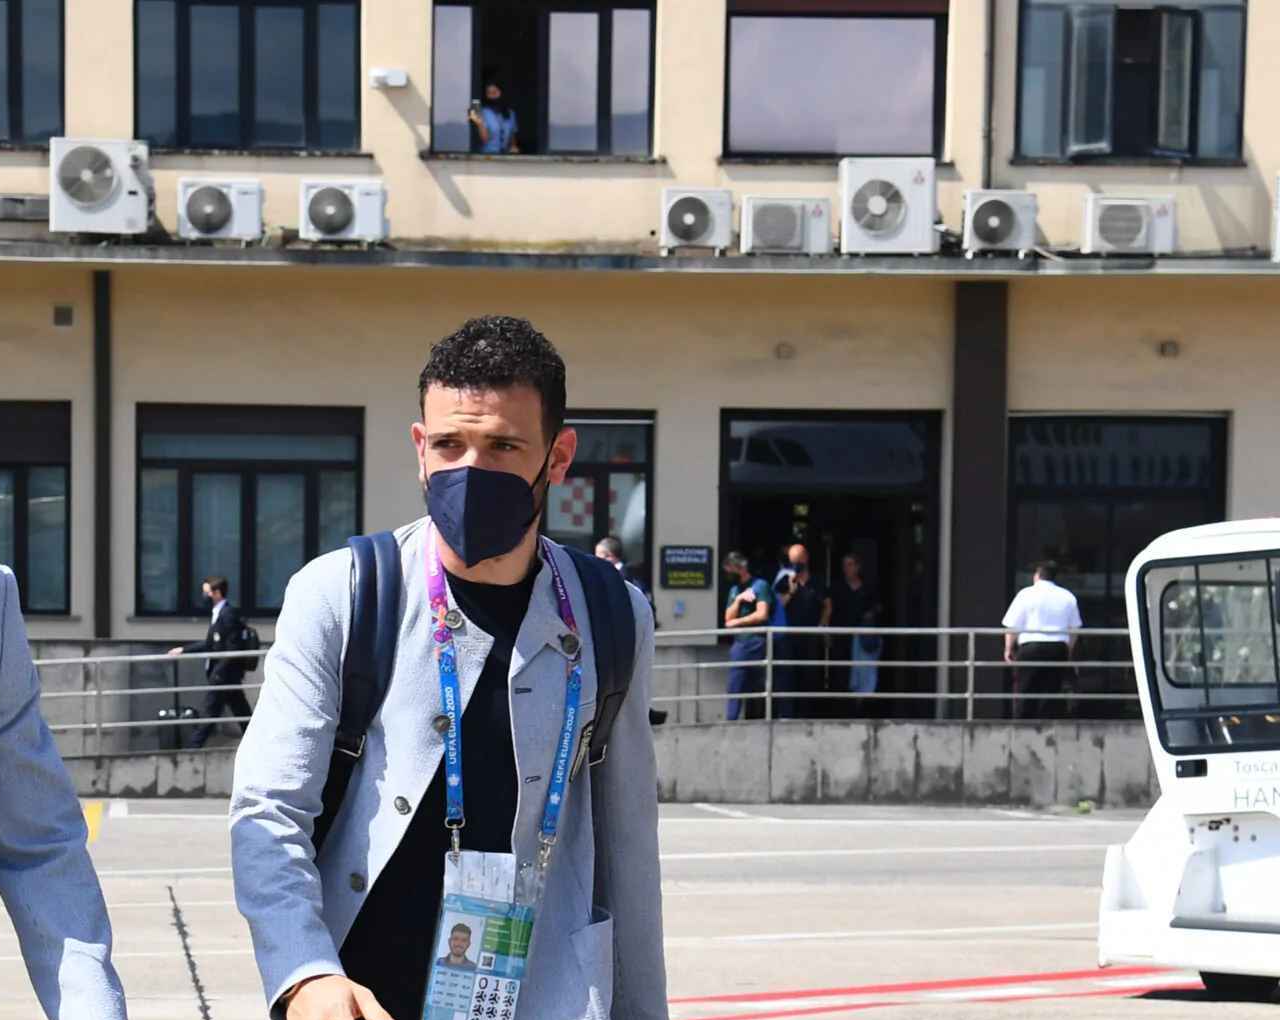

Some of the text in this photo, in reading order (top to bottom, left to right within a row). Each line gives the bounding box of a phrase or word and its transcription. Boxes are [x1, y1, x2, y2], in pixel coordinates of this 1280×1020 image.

[445, 686, 455, 711] 2020
[448, 740, 457, 764] UEFA
[556, 707, 575, 783] UEFA EURO 2020
[478, 977, 488, 990] 0
[493, 979, 500, 992] 1
